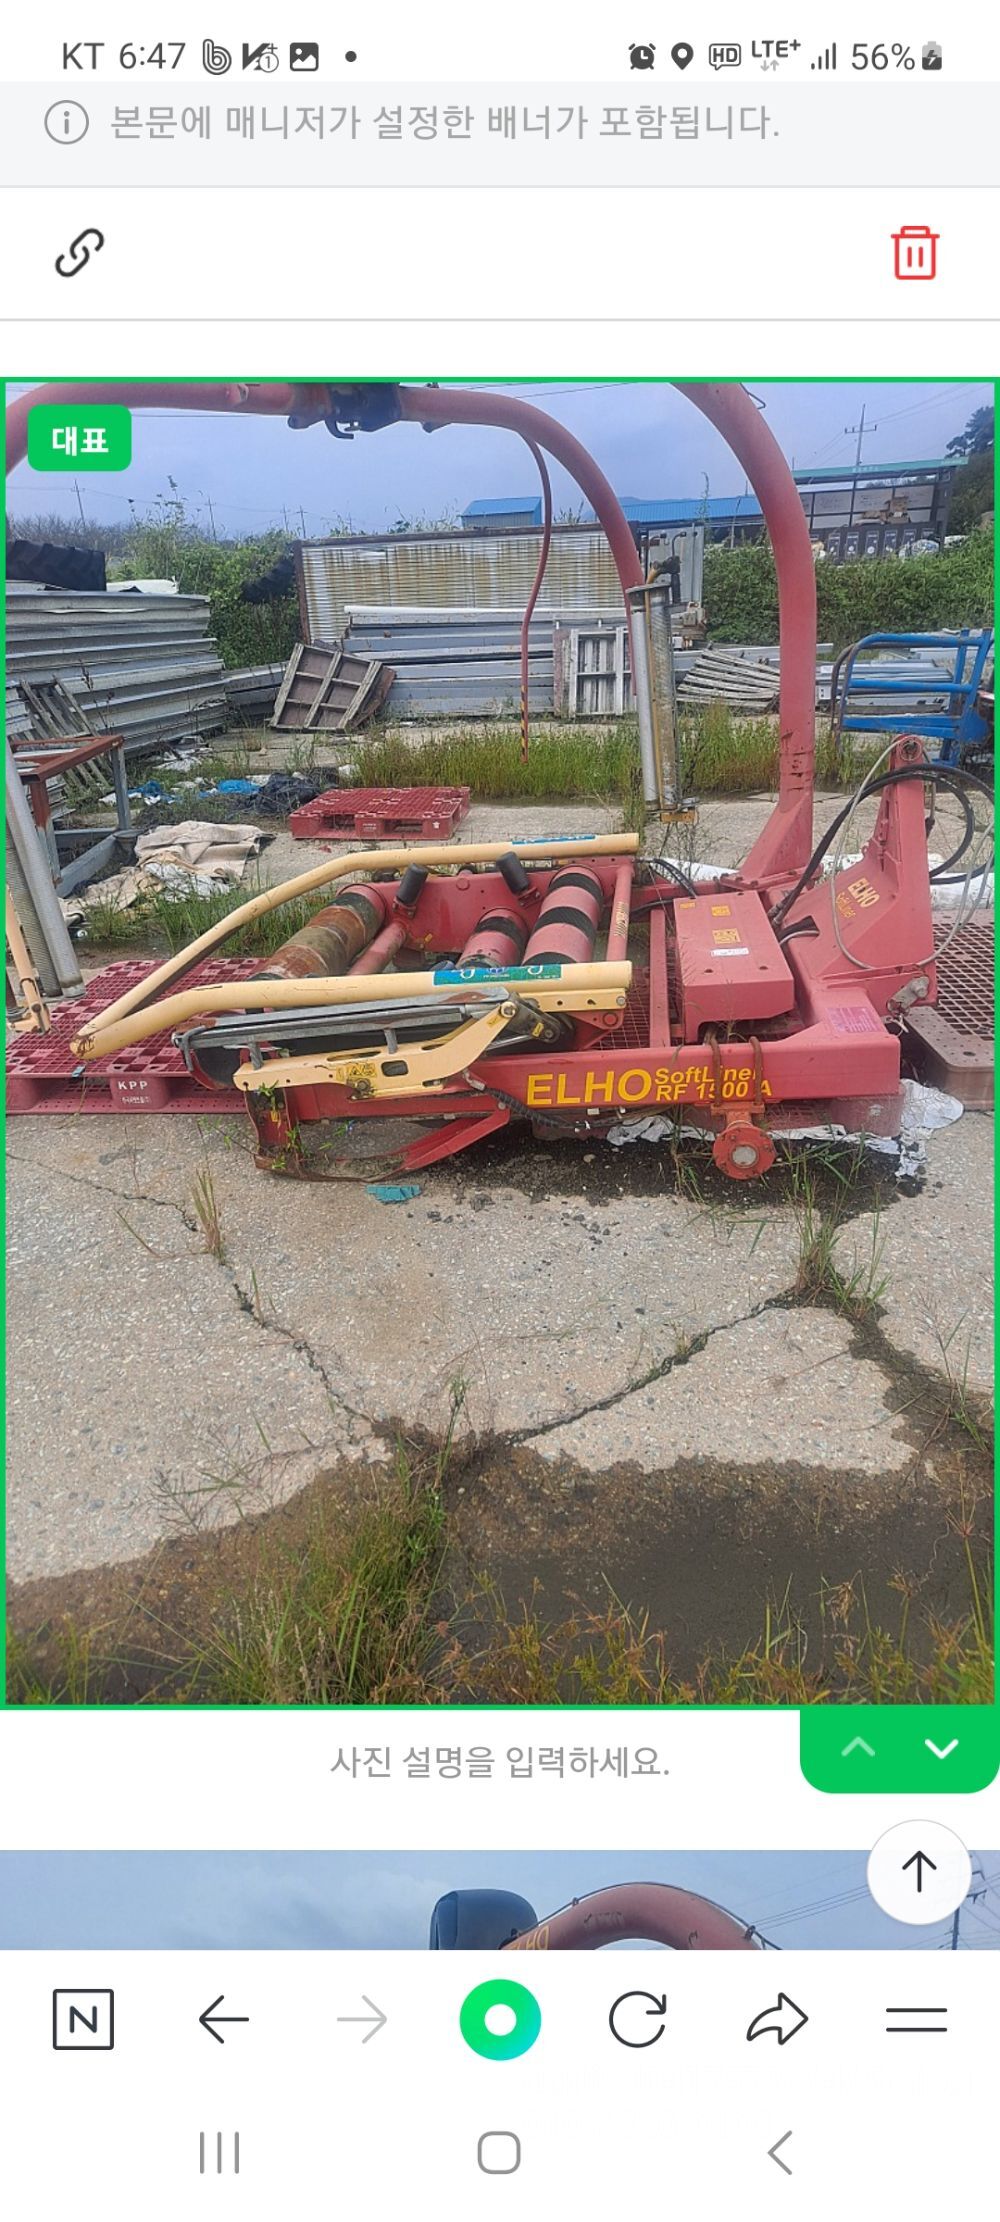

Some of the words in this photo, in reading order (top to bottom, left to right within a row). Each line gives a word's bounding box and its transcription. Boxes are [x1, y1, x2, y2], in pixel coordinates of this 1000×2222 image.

[62, 41, 106, 71] KT
[119, 41, 187, 70] 6:47
[713, 47, 738, 63] HD
[751, 38, 802, 59] LTE+
[851, 42, 916, 71] 56%
[110, 105, 211, 140] 본문에
[226, 105, 362, 140] 매니저가
[372, 105, 475, 141] 설정한
[488, 105, 589, 140] 배너가
[599, 104, 780, 140] 포함됩니다.
[52, 426, 110, 457] 대표
[847, 877, 881, 909] ELHO
[117, 1080, 149, 1091] KPP
[526, 1068, 652, 1107] ELHO
[656, 1083, 689, 1102] RF
[757, 1079, 773, 1097] A
[329, 1746, 392, 1779] 사진
[402, 1745, 496, 1780] 설명을
[505, 1746, 670, 1779] 입력하세요.
